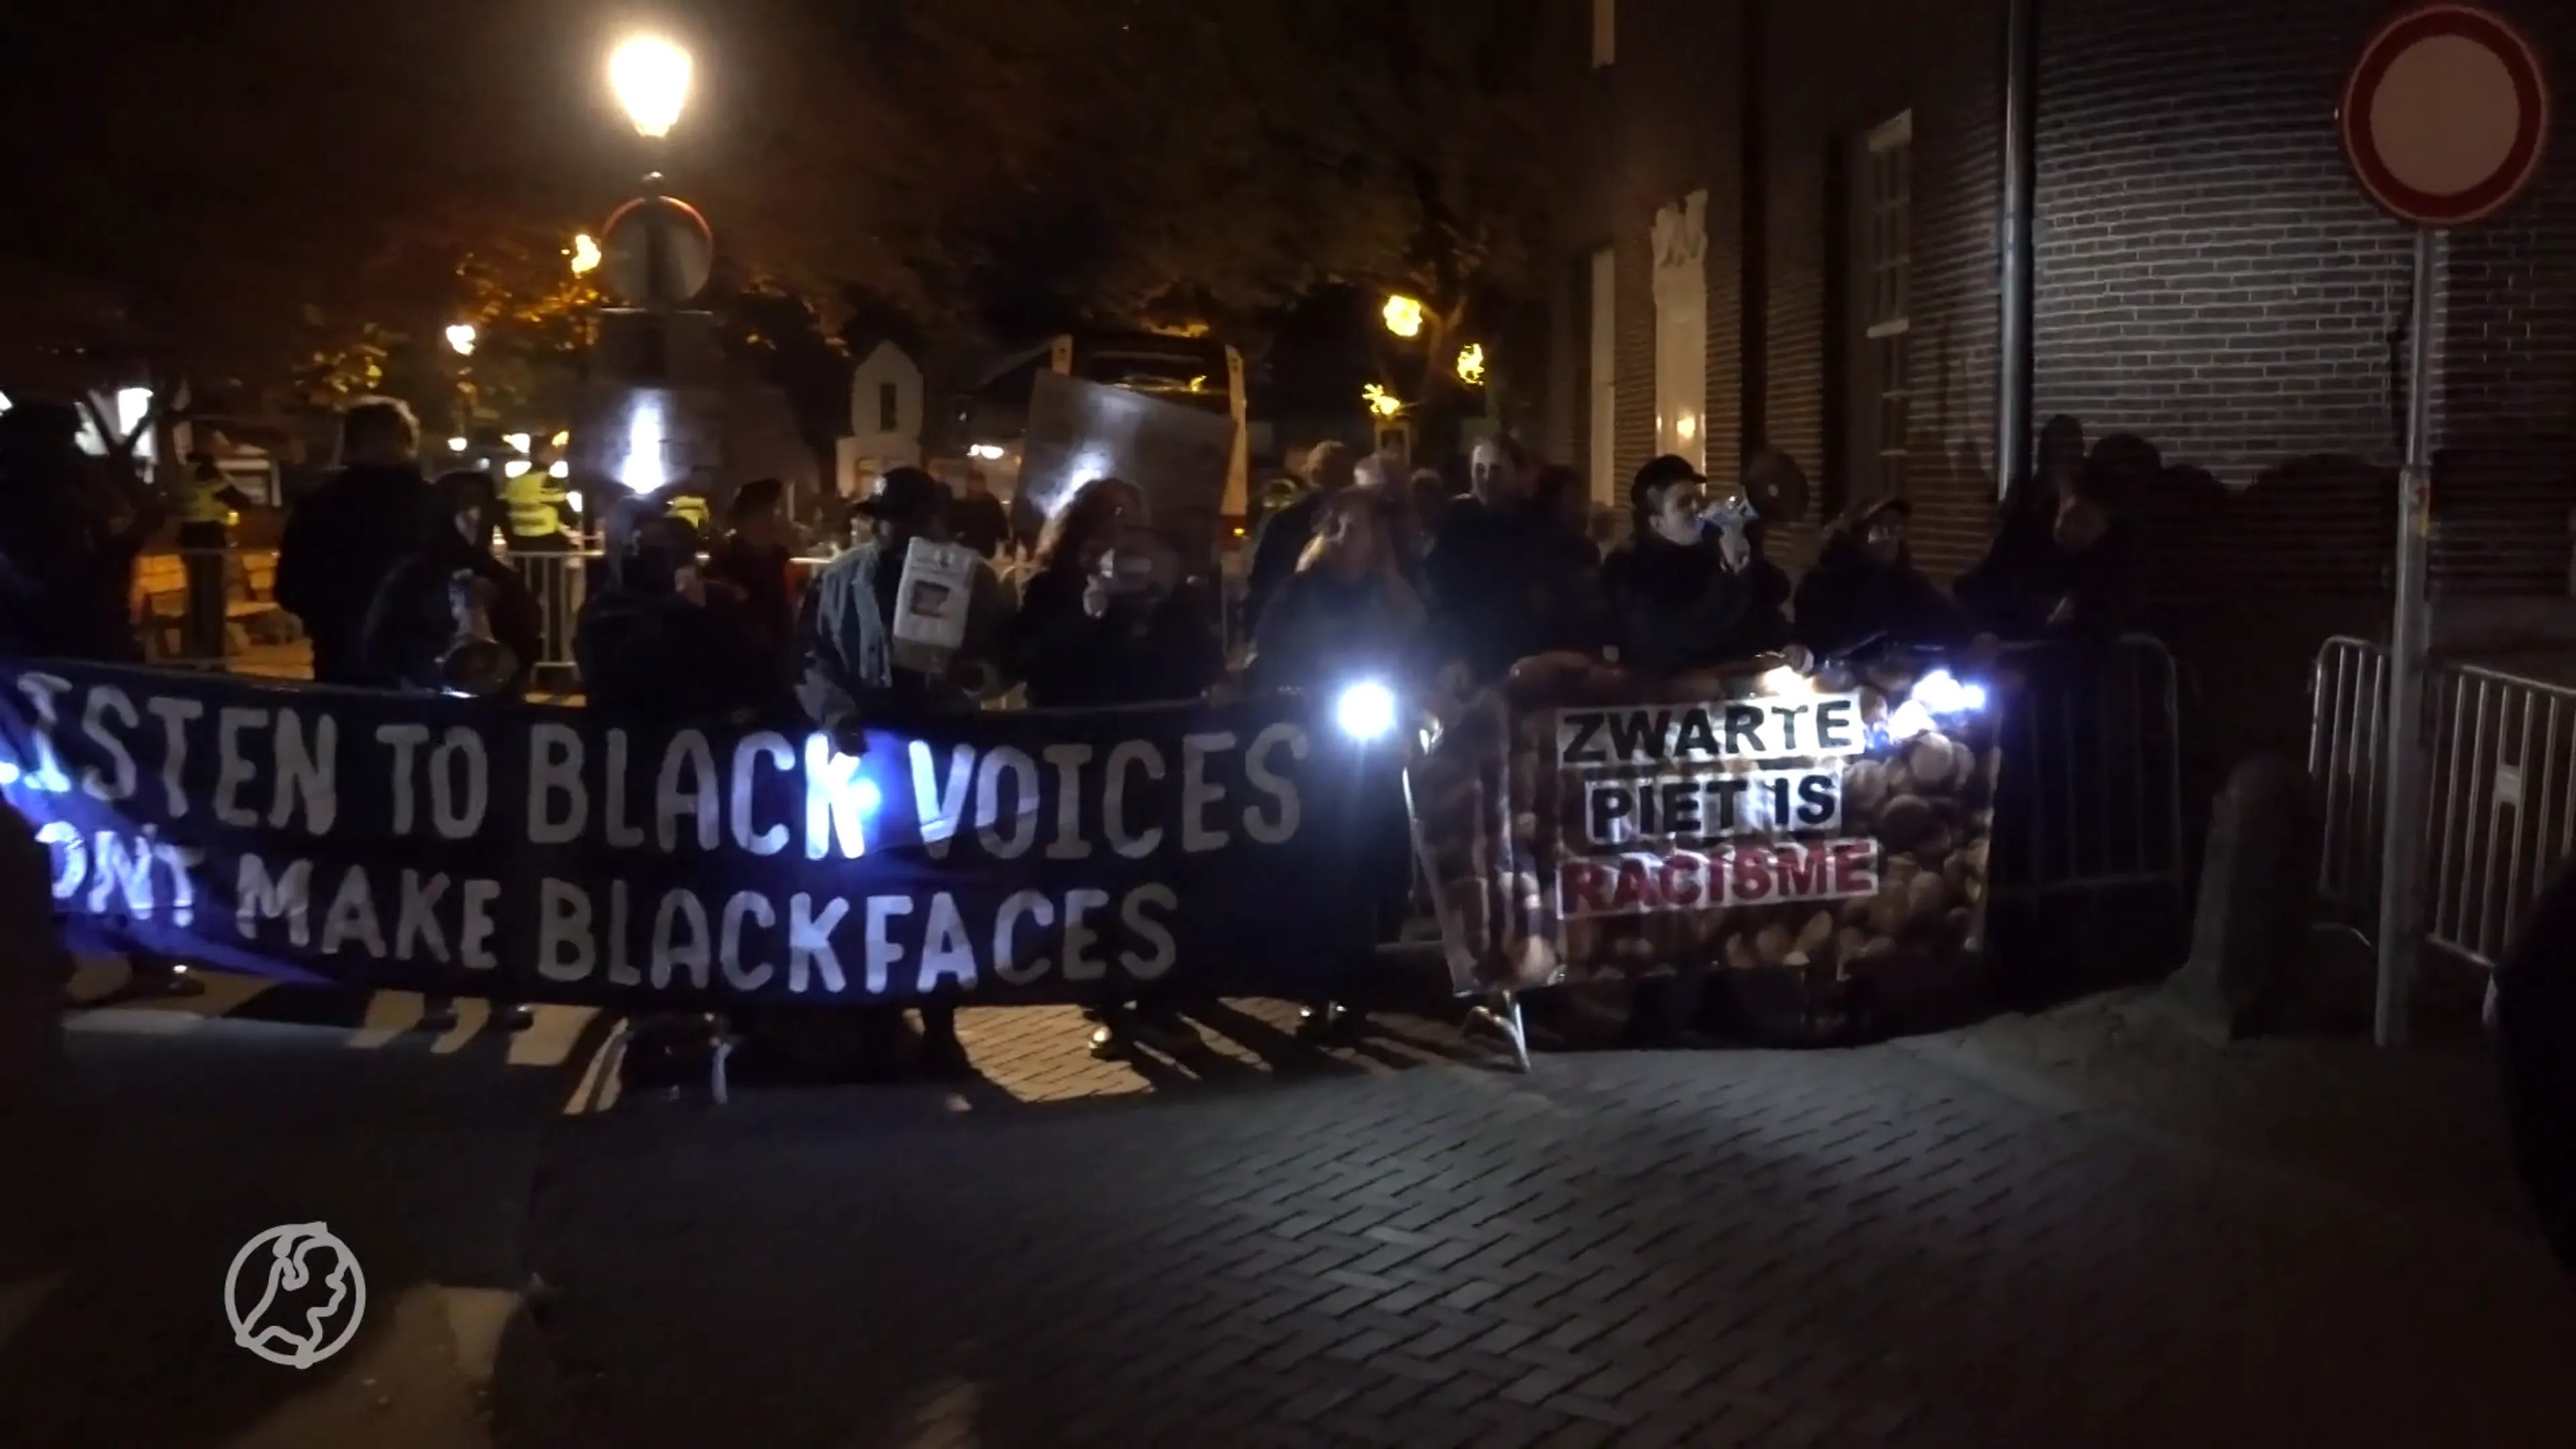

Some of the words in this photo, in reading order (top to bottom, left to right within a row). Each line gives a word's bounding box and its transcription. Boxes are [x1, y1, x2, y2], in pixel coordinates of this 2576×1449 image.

[1563, 700, 1852, 763] ZWARTE
[376, 724, 488, 839] TO
[527, 723, 866, 861] BLACK
[908, 722, 1309, 860] VOICES
[1592, 779, 1746, 839] PIET
[1773, 774, 1836, 825] IS
[1560, 840, 1874, 913] RACISME
[236, 853, 500, 970] MAKE
[538, 877, 1179, 994] BLACKFACES
